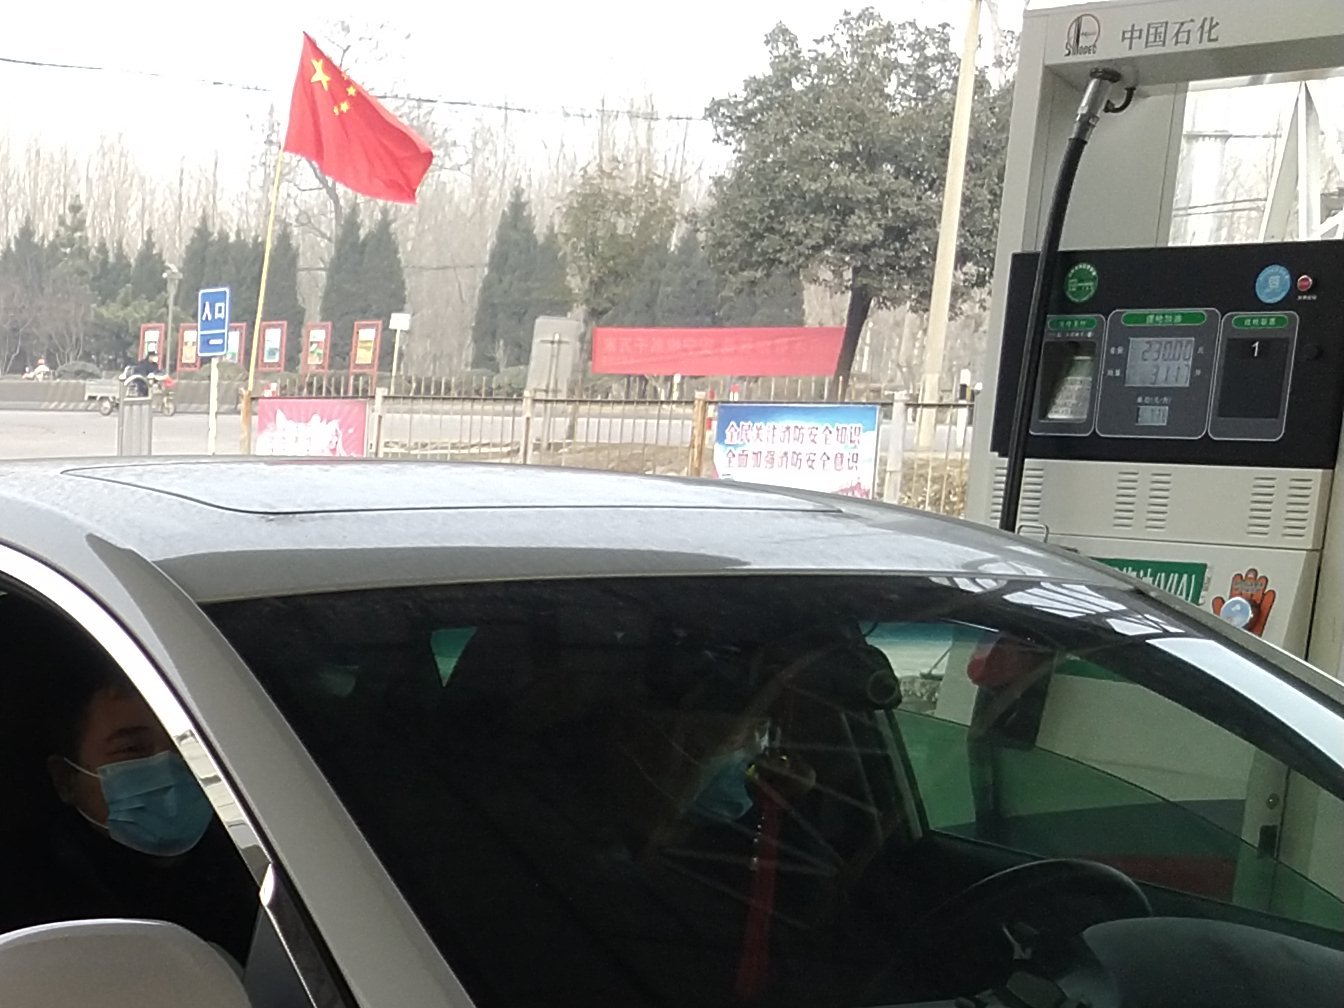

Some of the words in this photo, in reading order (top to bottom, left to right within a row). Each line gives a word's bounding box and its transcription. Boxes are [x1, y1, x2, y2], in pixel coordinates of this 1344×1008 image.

[1121, 16, 1220, 51] 中国石化
[201, 301, 226, 321] 入口
[726, 423, 861, 445] 全民关注消防安全知识
[726, 449, 859, 470] 全面加强消防安全意识
